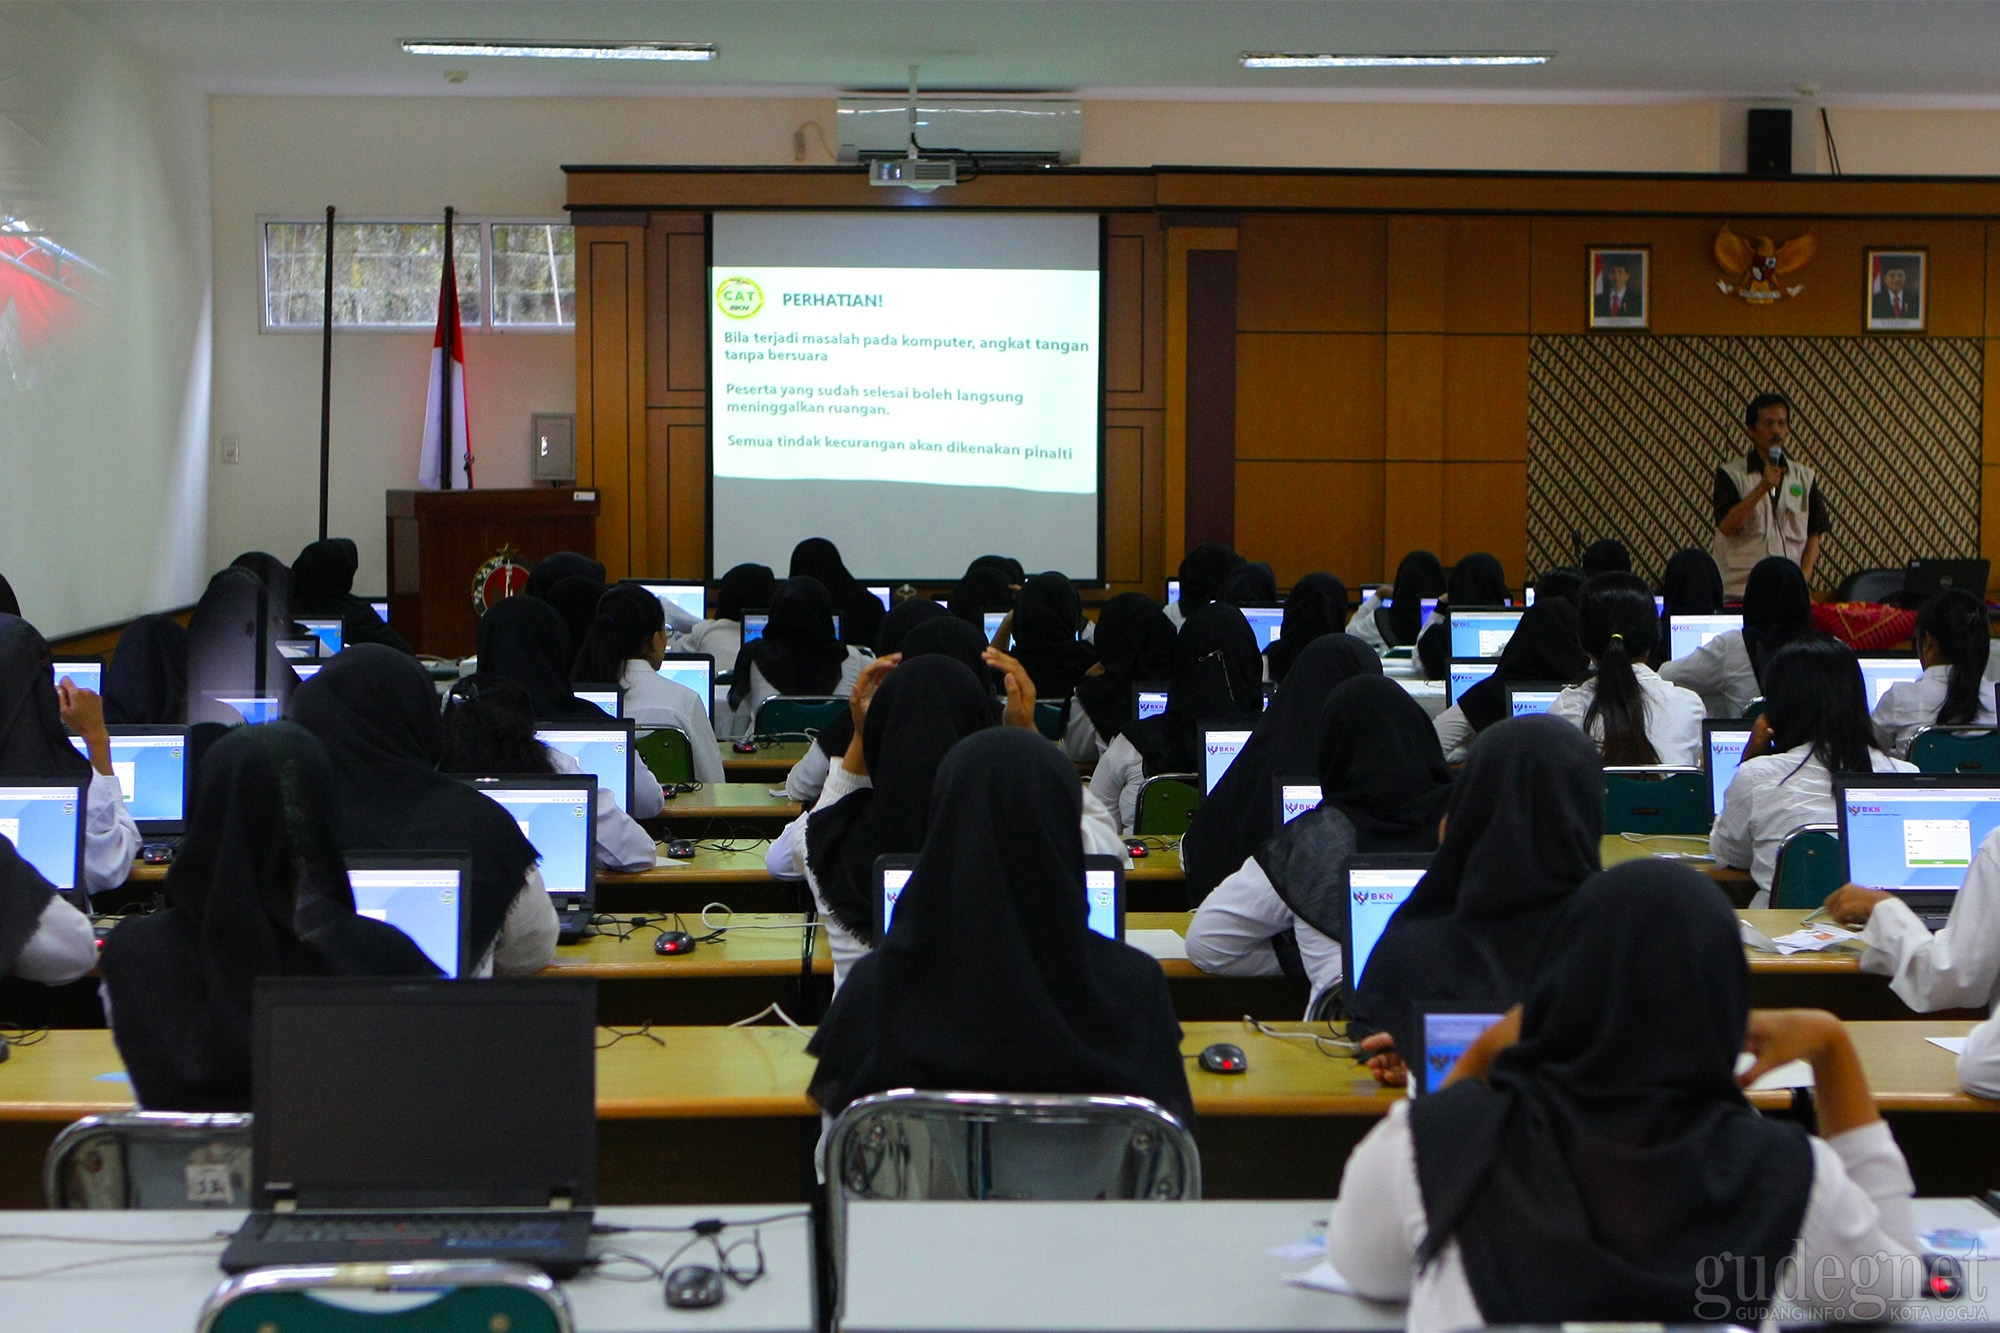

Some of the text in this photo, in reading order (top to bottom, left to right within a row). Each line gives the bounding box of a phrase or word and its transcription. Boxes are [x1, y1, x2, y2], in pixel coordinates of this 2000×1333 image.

[723, 290, 755, 301] CAT
[782, 293, 884, 307] PERHATIAN!
[724, 331, 1089, 354] Bila terjadi masalah pada komputer, angkat tangan
[724, 349, 829, 363] tanpa bersuara
[726, 384, 1024, 405] Peserta yang sudah selesai boleh langsung
[726, 401, 890, 417] meninggalkan ruangan.
[727, 435, 1073, 461] Semua tindak kecurangan akan dikenakan pinalti
[1370, 892, 1394, 900] BKN
